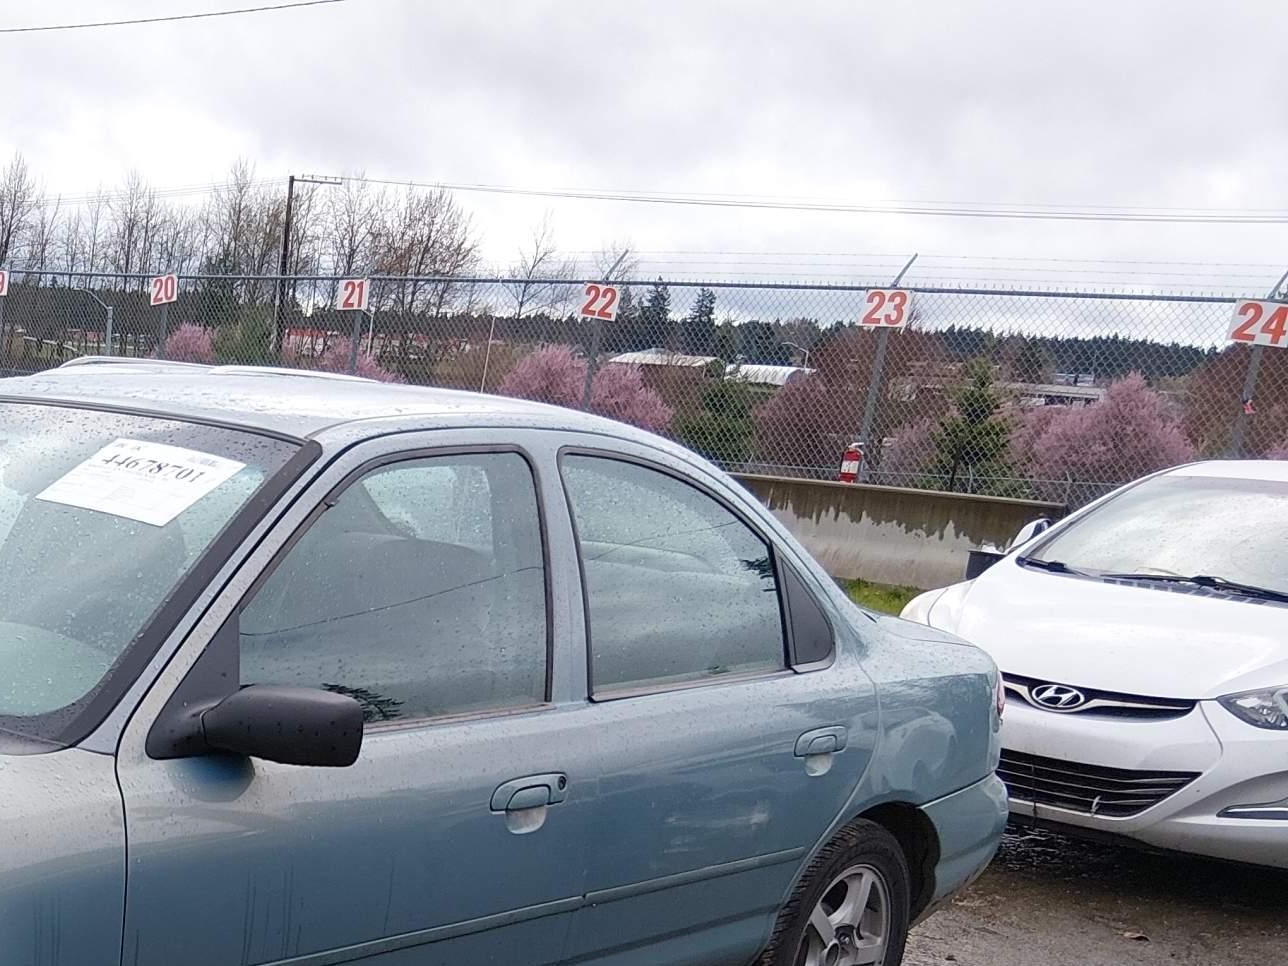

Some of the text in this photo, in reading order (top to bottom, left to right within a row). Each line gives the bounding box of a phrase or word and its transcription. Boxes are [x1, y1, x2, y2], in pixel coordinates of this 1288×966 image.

[152, 276, 175, 303] 20
[342, 280, 364, 308] 21
[580, 284, 618, 319] 22
[862, 290, 908, 325] 23
[1230, 302, 1288, 345] 24
[101, 453, 206, 483] 44678701
